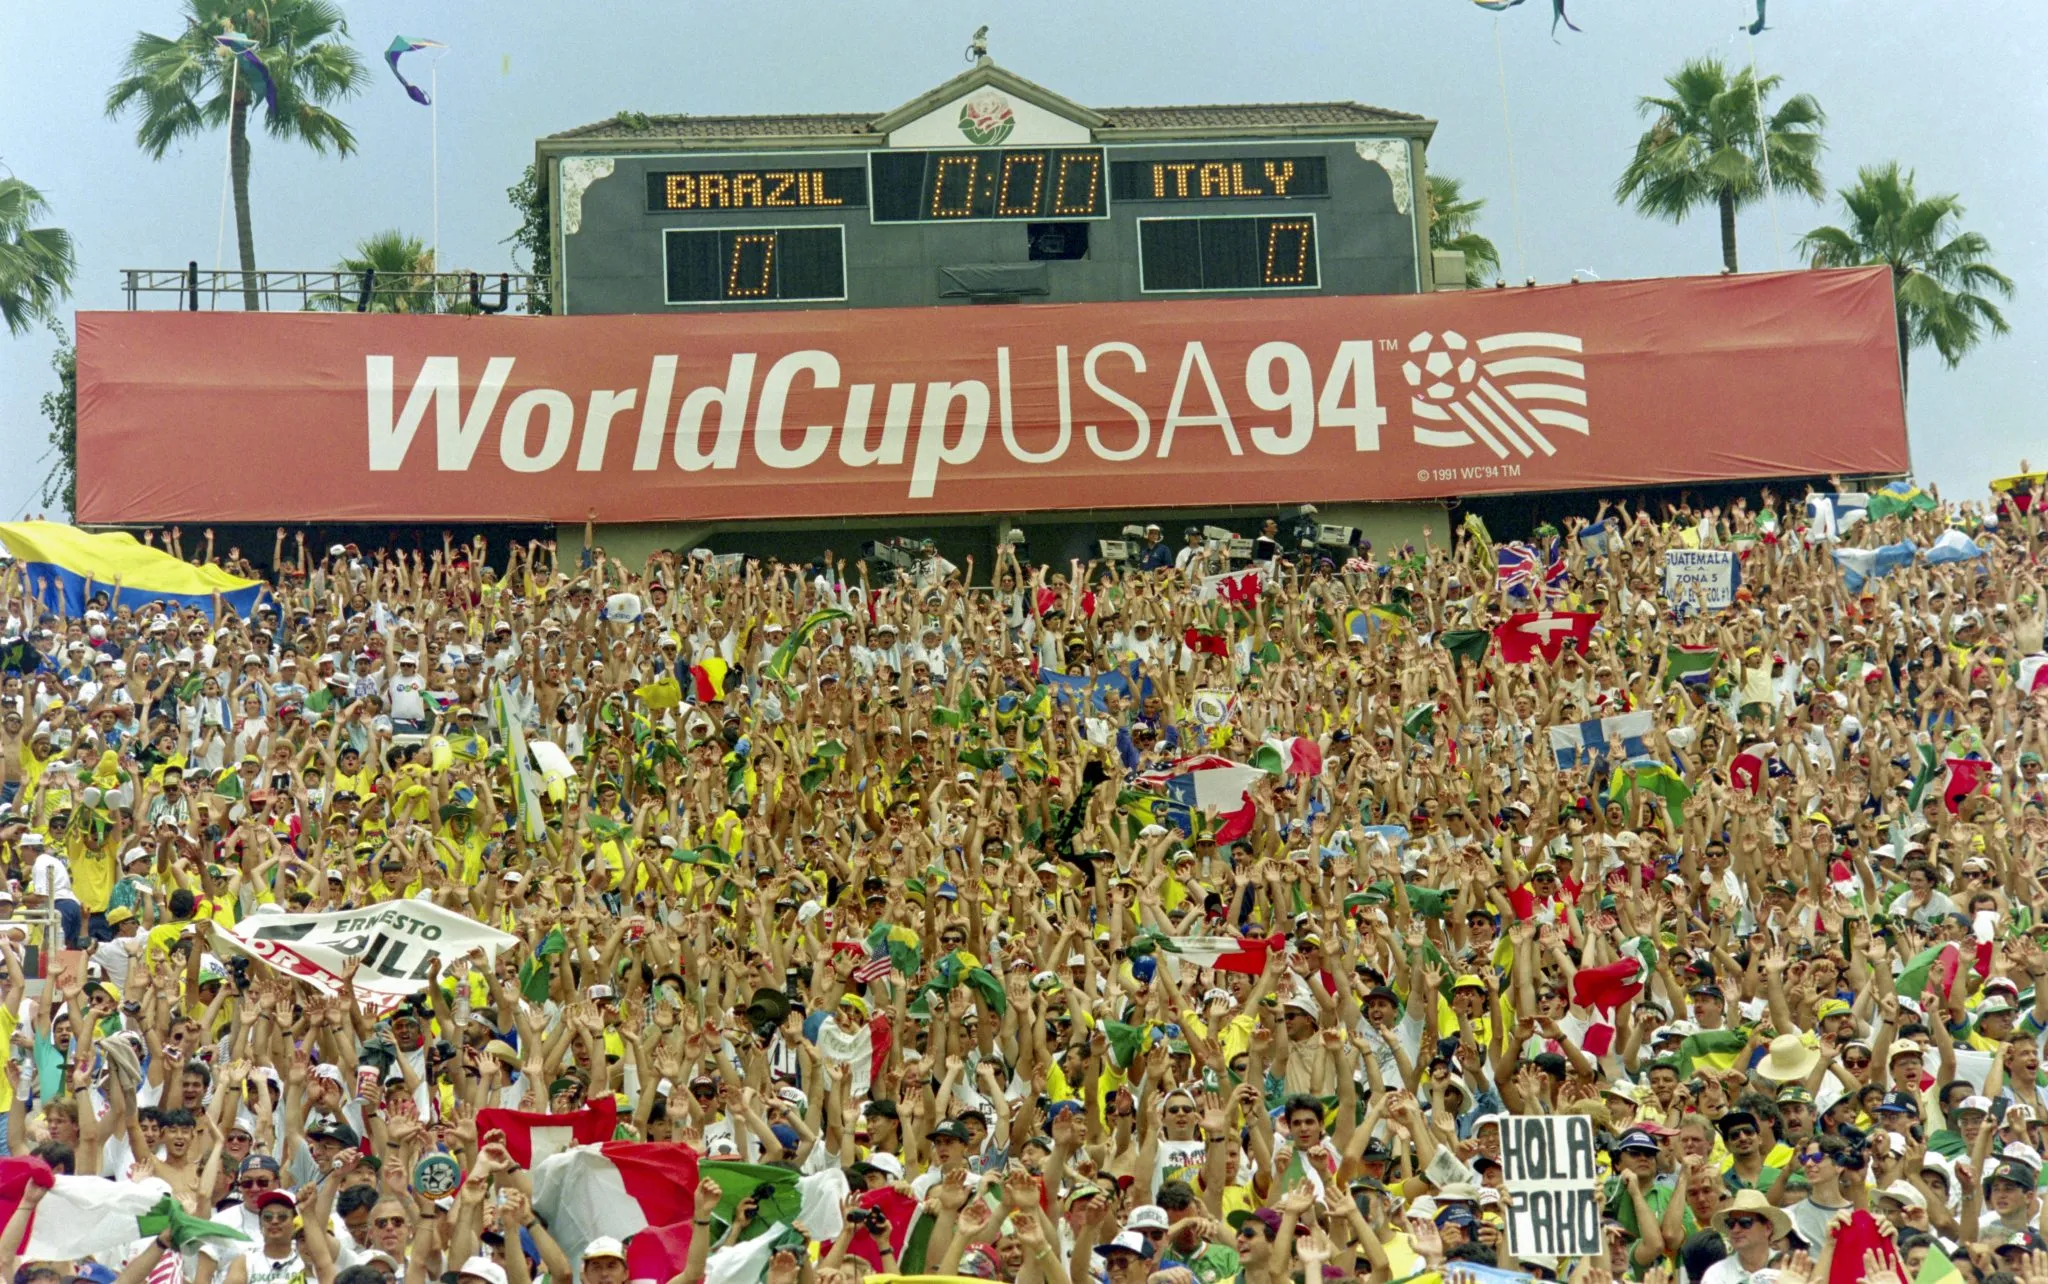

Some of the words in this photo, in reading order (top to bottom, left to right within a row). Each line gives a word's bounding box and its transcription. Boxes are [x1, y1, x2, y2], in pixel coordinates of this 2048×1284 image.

[666, 171, 844, 209] BRAZIL
[931, 154, 1100, 216] 0:00
[1152, 161, 1294, 197] ITALY
[727, 234, 775, 296] 0
[1265, 223, 1309, 283] 0
[996, 340, 1244, 464] USA
[1245, 340, 1388, 455] 94
[1379, 339, 1398, 351] TM
[1432, 468, 1457, 481] 1991
[1460, 466, 1499, 480] WC'94
[1501, 464, 1521, 477] TM
[1665, 551, 1729, 566] GUATEMALA
[1676, 573, 1708, 584] ZONA
[332, 909, 442, 941] ERNESTO
[1500, 1116, 1594, 1180] HOLA
[1507, 1188, 1600, 1254] PAHO
